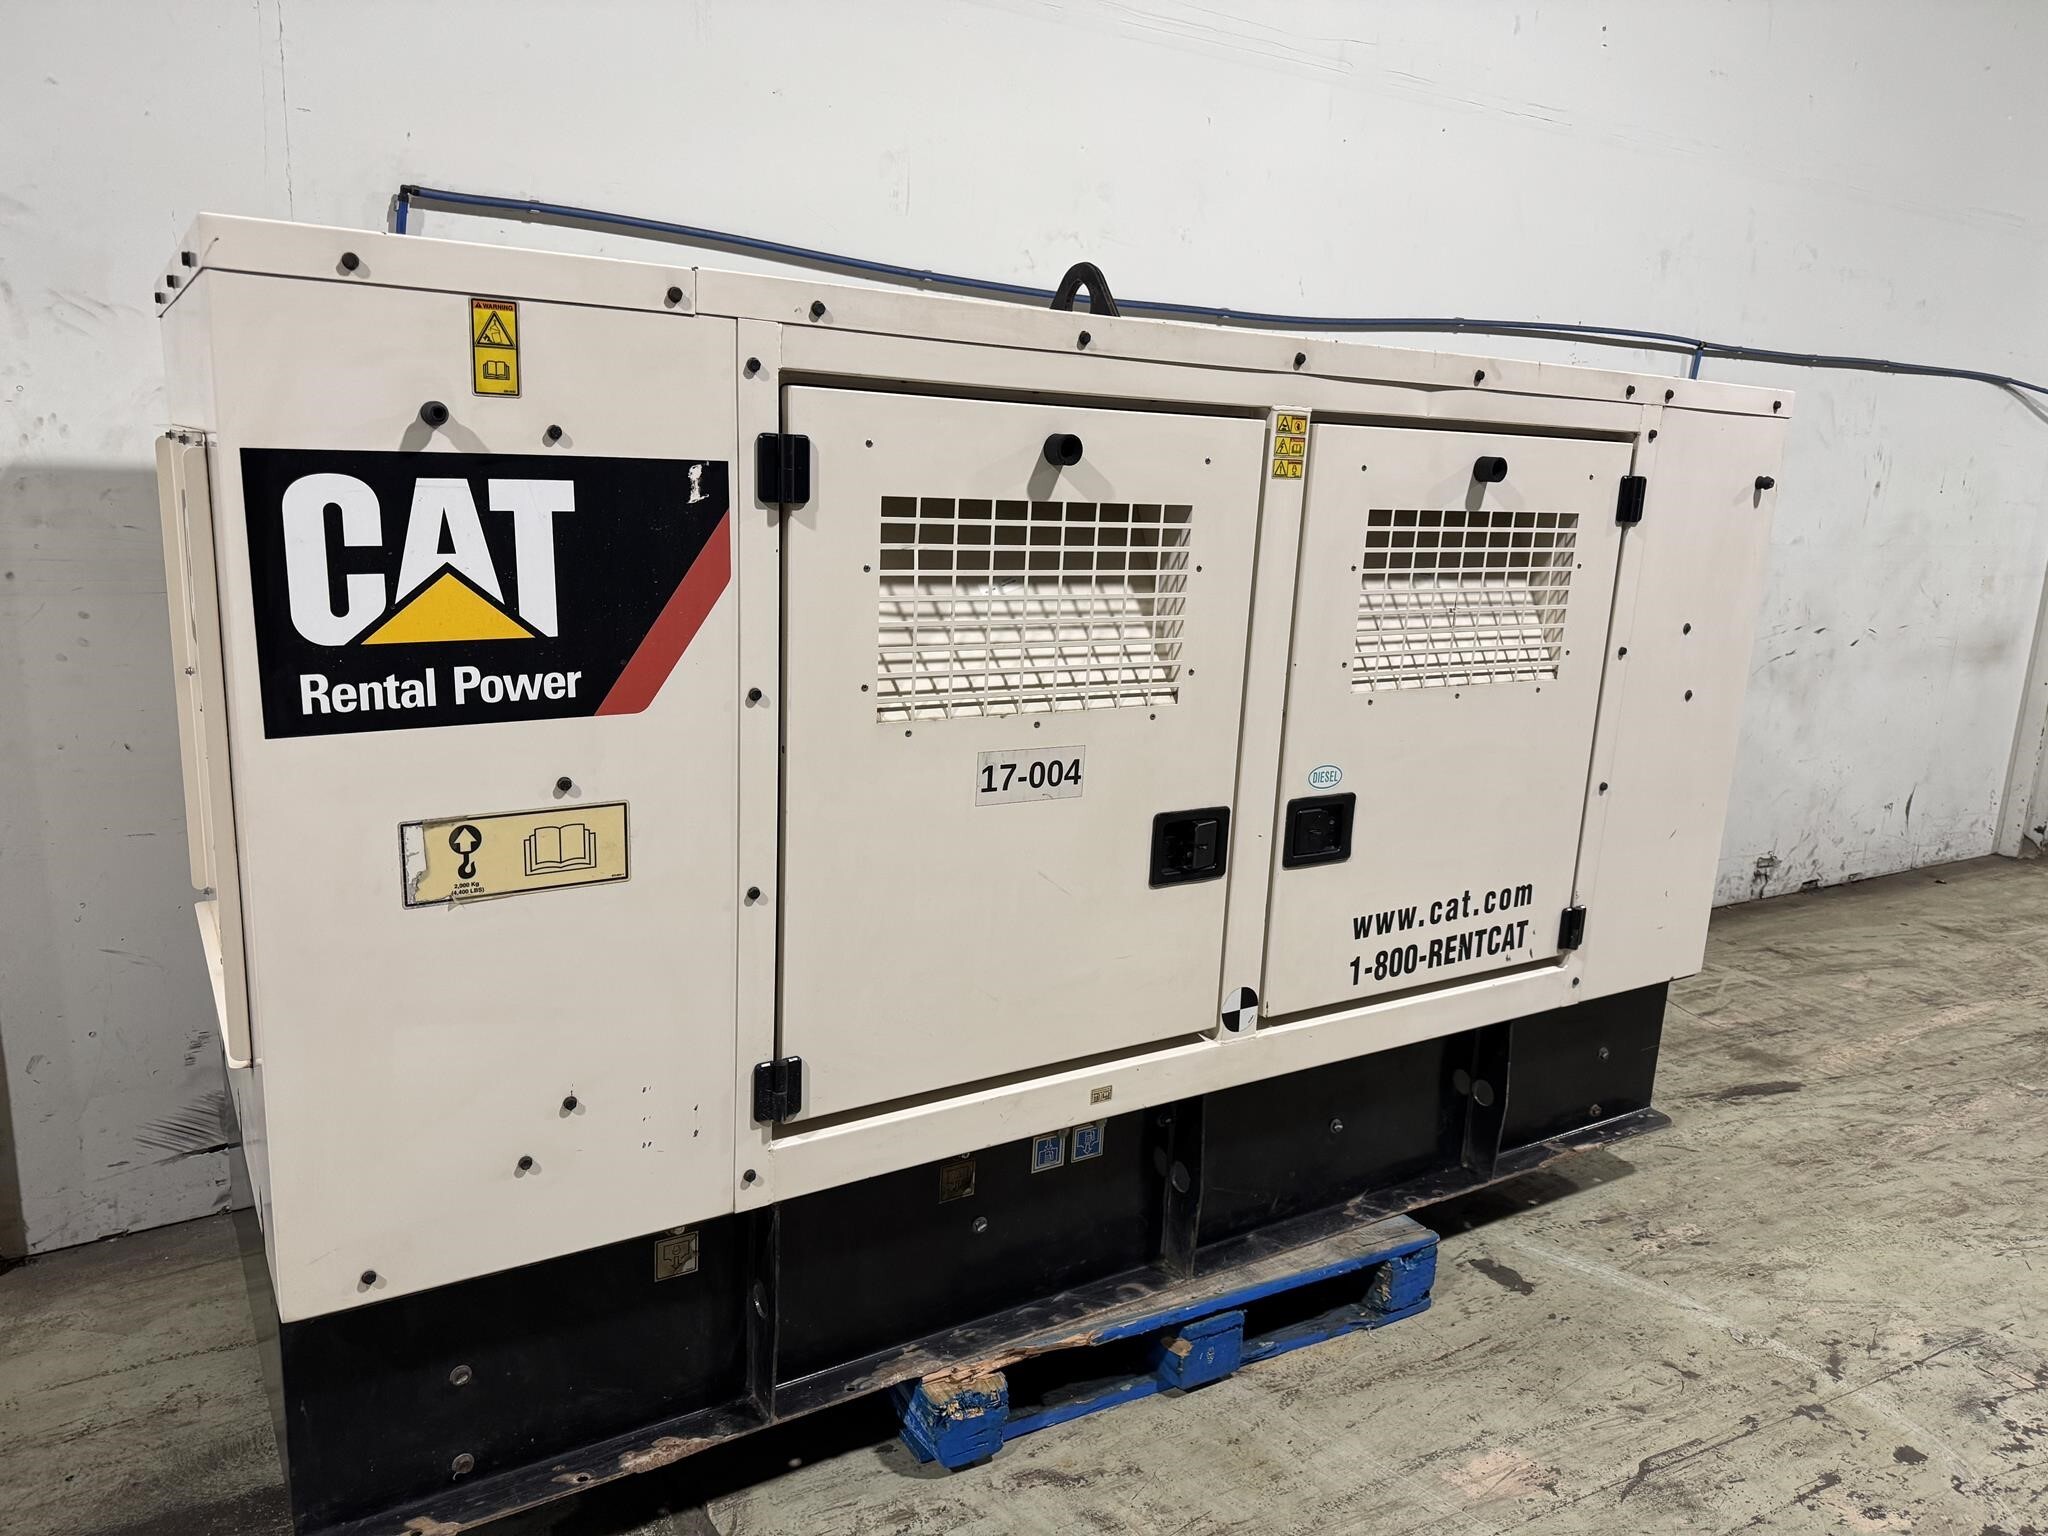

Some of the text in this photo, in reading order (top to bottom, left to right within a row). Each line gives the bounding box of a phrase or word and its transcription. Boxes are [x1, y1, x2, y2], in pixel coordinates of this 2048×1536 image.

[482, 302, 513, 311] WARNING
[282, 473, 575, 647] CAT
[299, 667, 582, 716] Rental Power
[980, 758, 1082, 793] 17-004
[1312, 770, 1338, 783] DIESEL
[1353, 883, 1533, 940] www.cat.com
[1349, 920, 1529, 986] 1-800-RENTCAT
